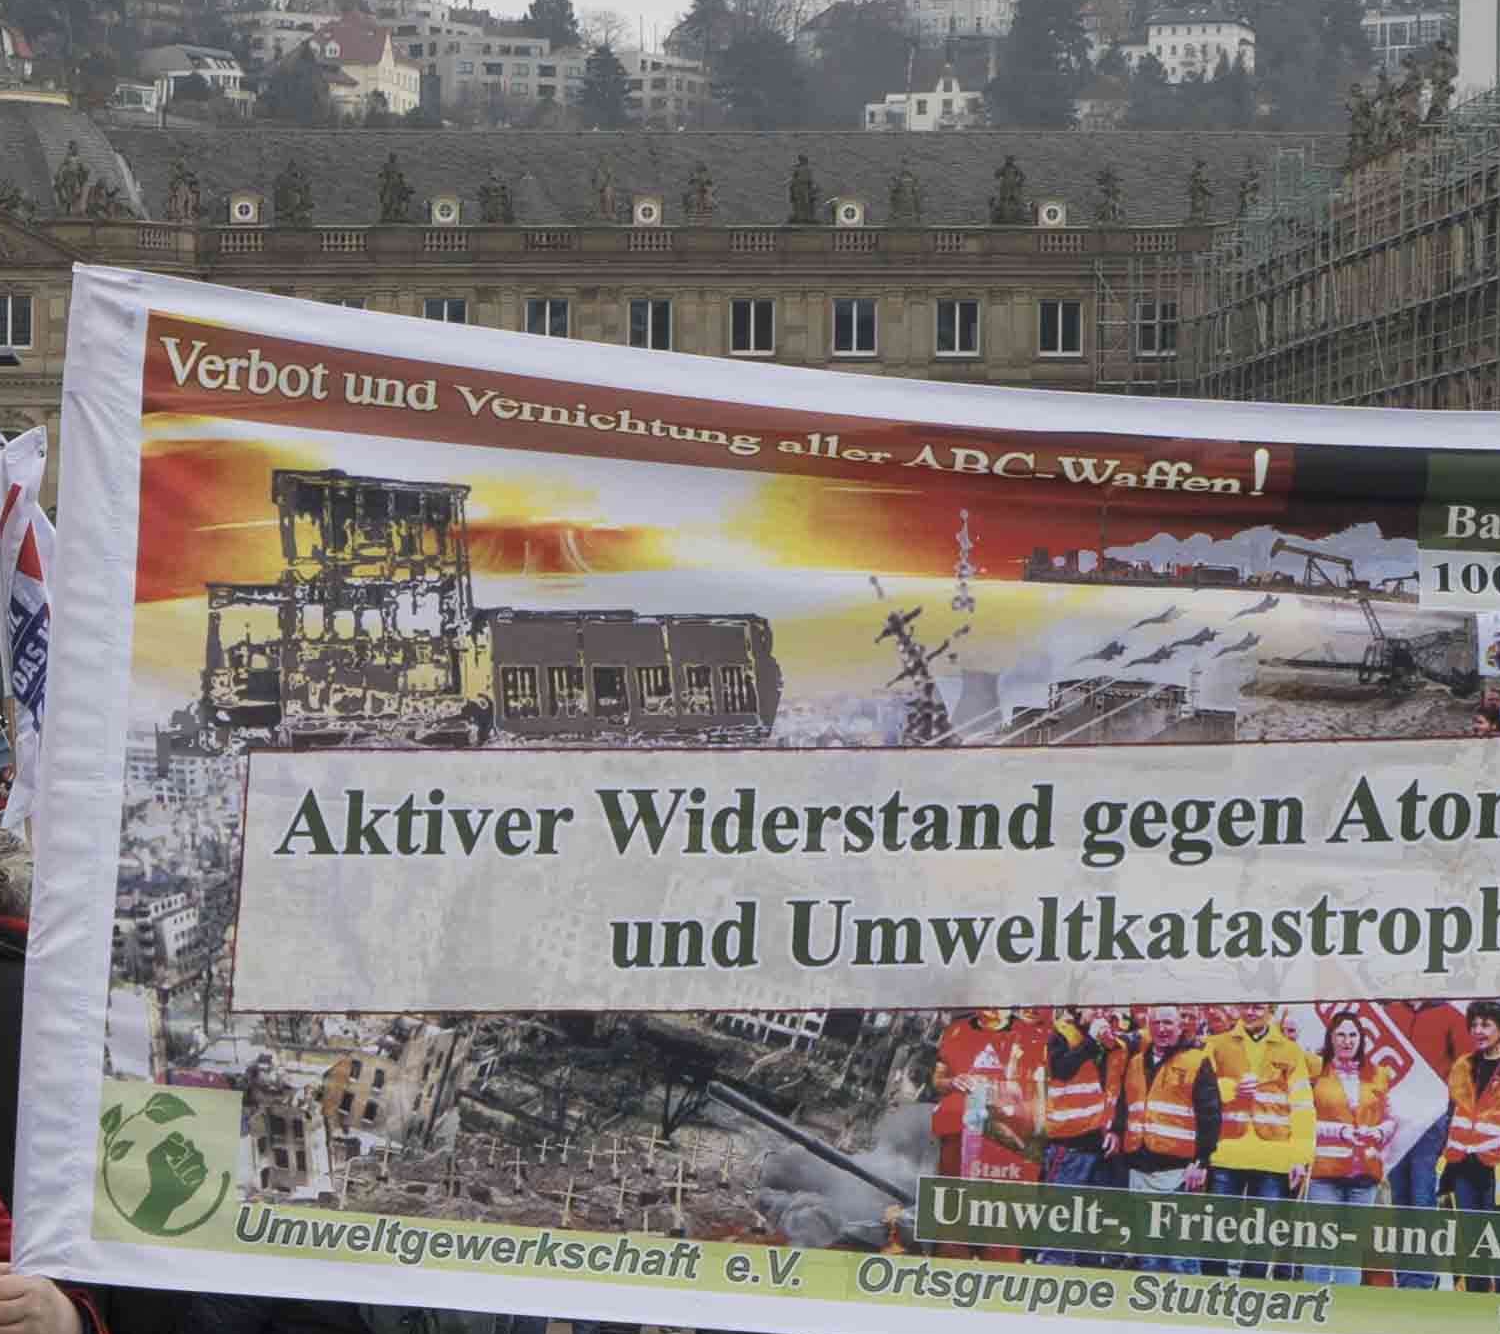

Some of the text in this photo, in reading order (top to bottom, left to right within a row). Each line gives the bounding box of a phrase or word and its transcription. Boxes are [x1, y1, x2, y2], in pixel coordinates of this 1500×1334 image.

[160, 336, 1271, 497] Verbot und Vernichtung aller ABC-Waffen!
[273, 787, 574, 857] Aktiver
[595, 782, 1055, 856] Widerstand
[1081, 796, 1305, 868] gegen
[609, 901, 759, 968] und
[932, 1185, 1132, 1246] Umwelt-,
[1149, 1196, 1357, 1250] Friedens-
[1373, 1219, 1457, 1257] und
[235, 1205, 701, 1280] Umweltgewerkschaft
[723, 1249, 802, 1287] e.V.
[857, 1256, 1114, 1314] Ortsgruppe
[1128, 1274, 1330, 1328] Stuttgart
